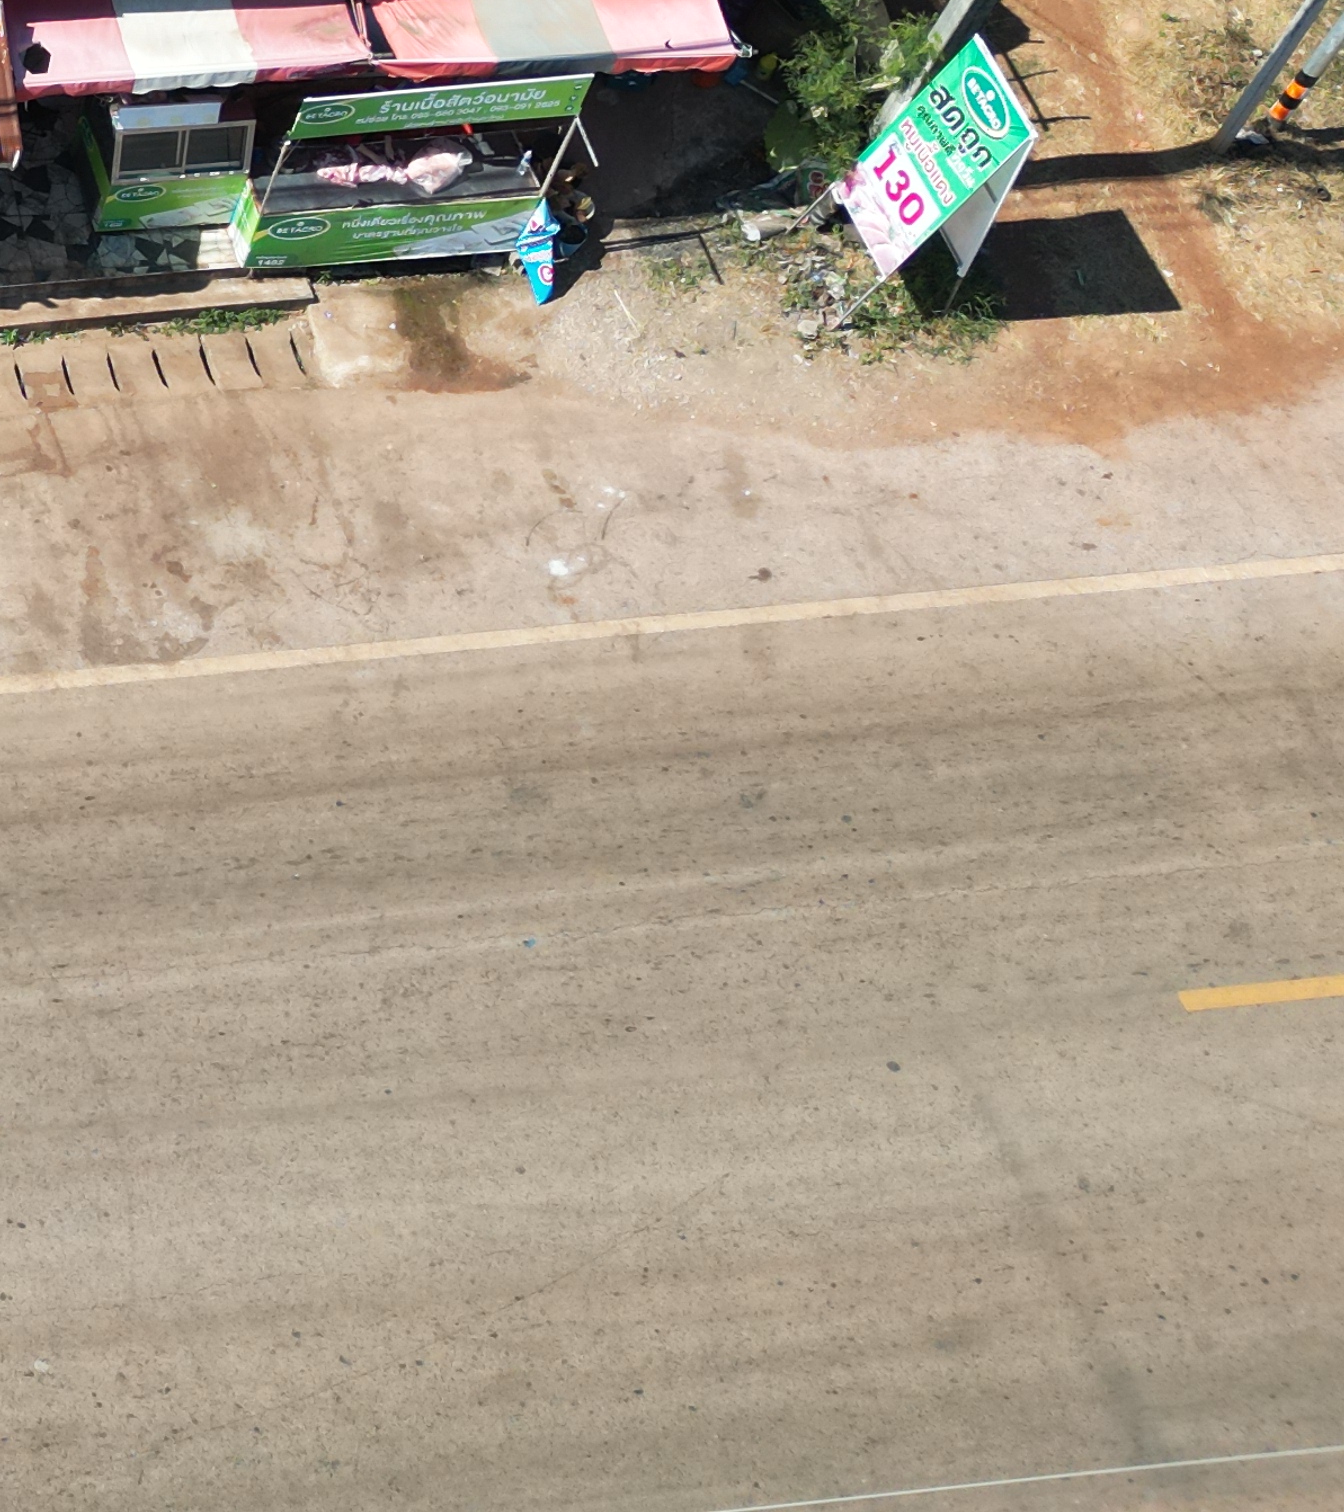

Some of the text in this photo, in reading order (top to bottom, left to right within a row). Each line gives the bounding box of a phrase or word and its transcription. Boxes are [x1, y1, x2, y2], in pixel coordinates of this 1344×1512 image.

[378, 88, 547, 114] ร้านเนื้อสัตว์อนามัย
[967, 78, 1002, 131] BETAGRO
[872, 148, 926, 227] 130
[898, 117, 957, 206] หมูเนื้อแดง
